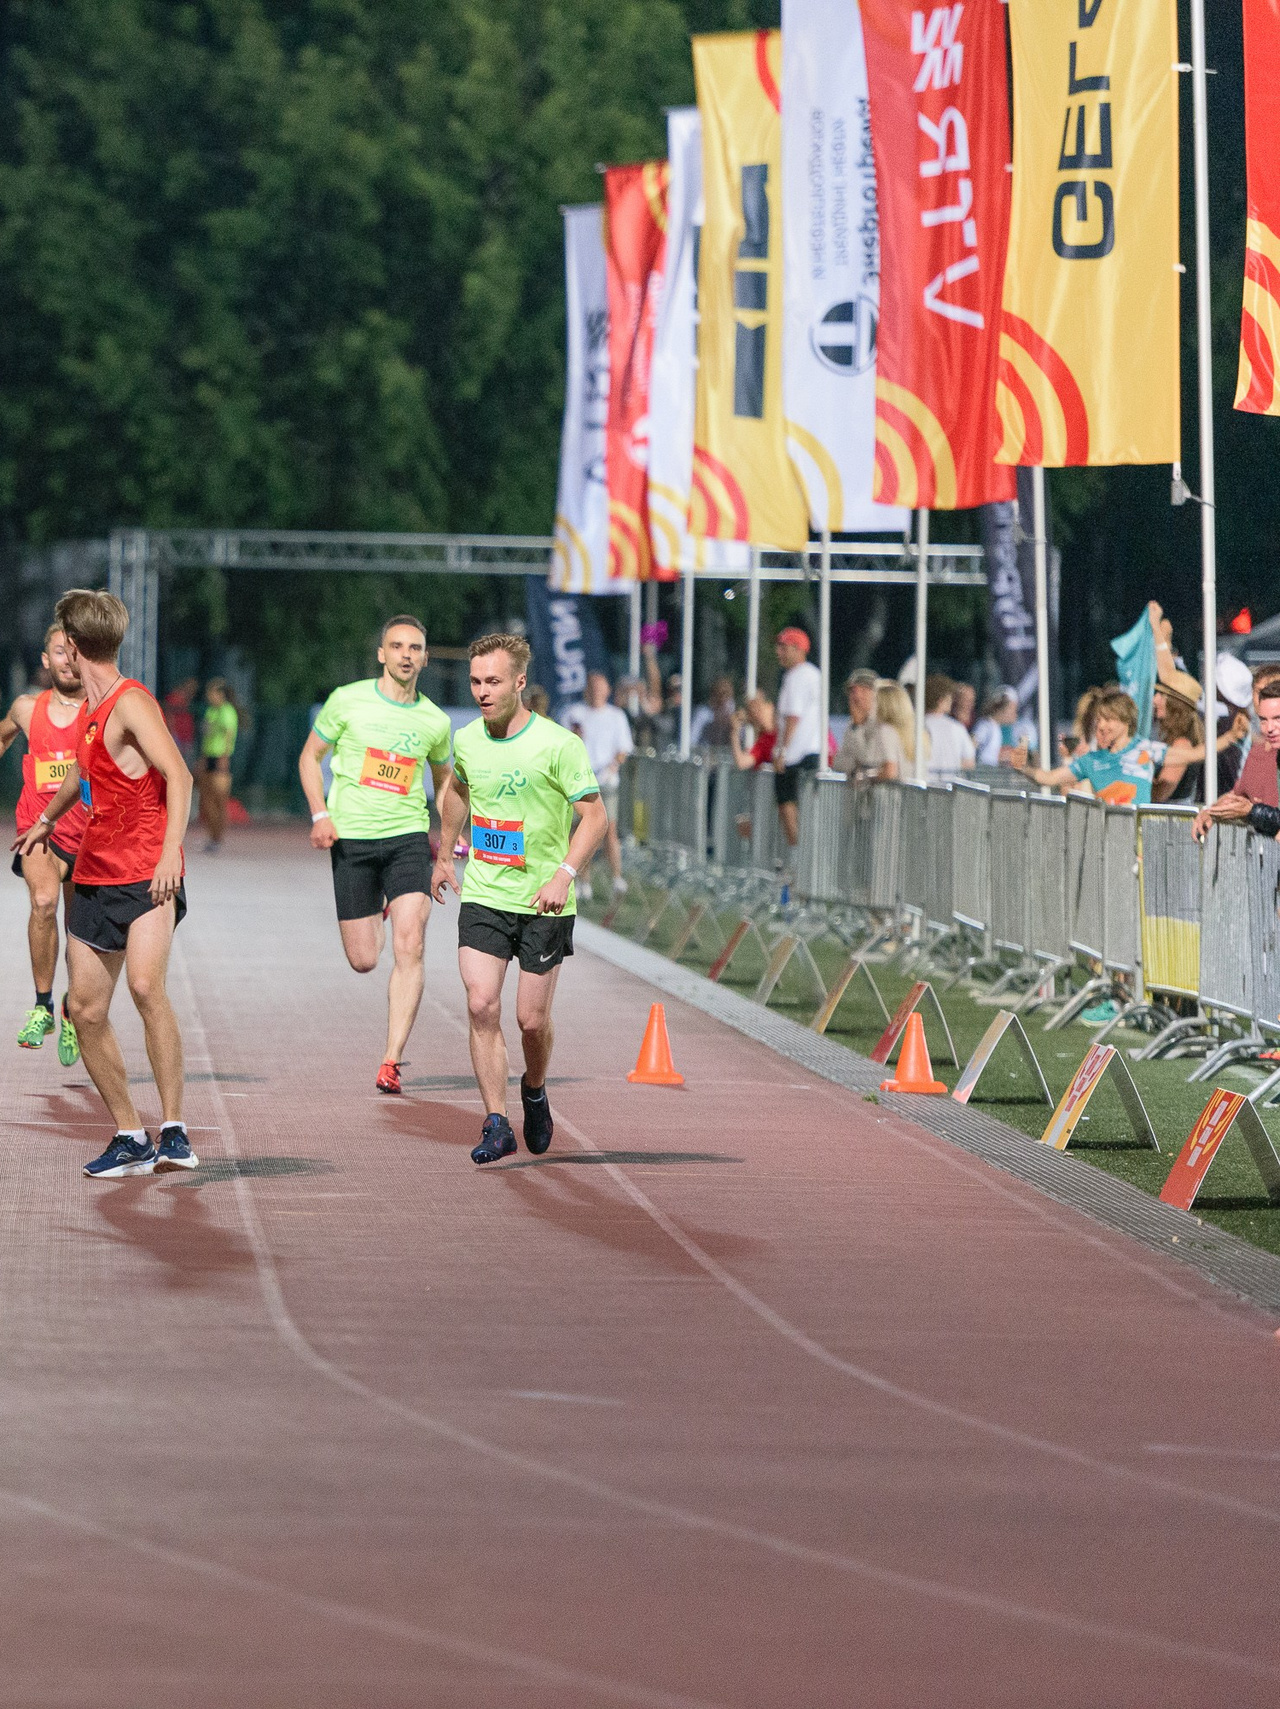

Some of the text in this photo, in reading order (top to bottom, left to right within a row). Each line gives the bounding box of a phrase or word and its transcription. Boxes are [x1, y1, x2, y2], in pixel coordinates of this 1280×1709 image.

[377, 763, 401, 780] 307
[484, 832, 518, 851] 307 3
